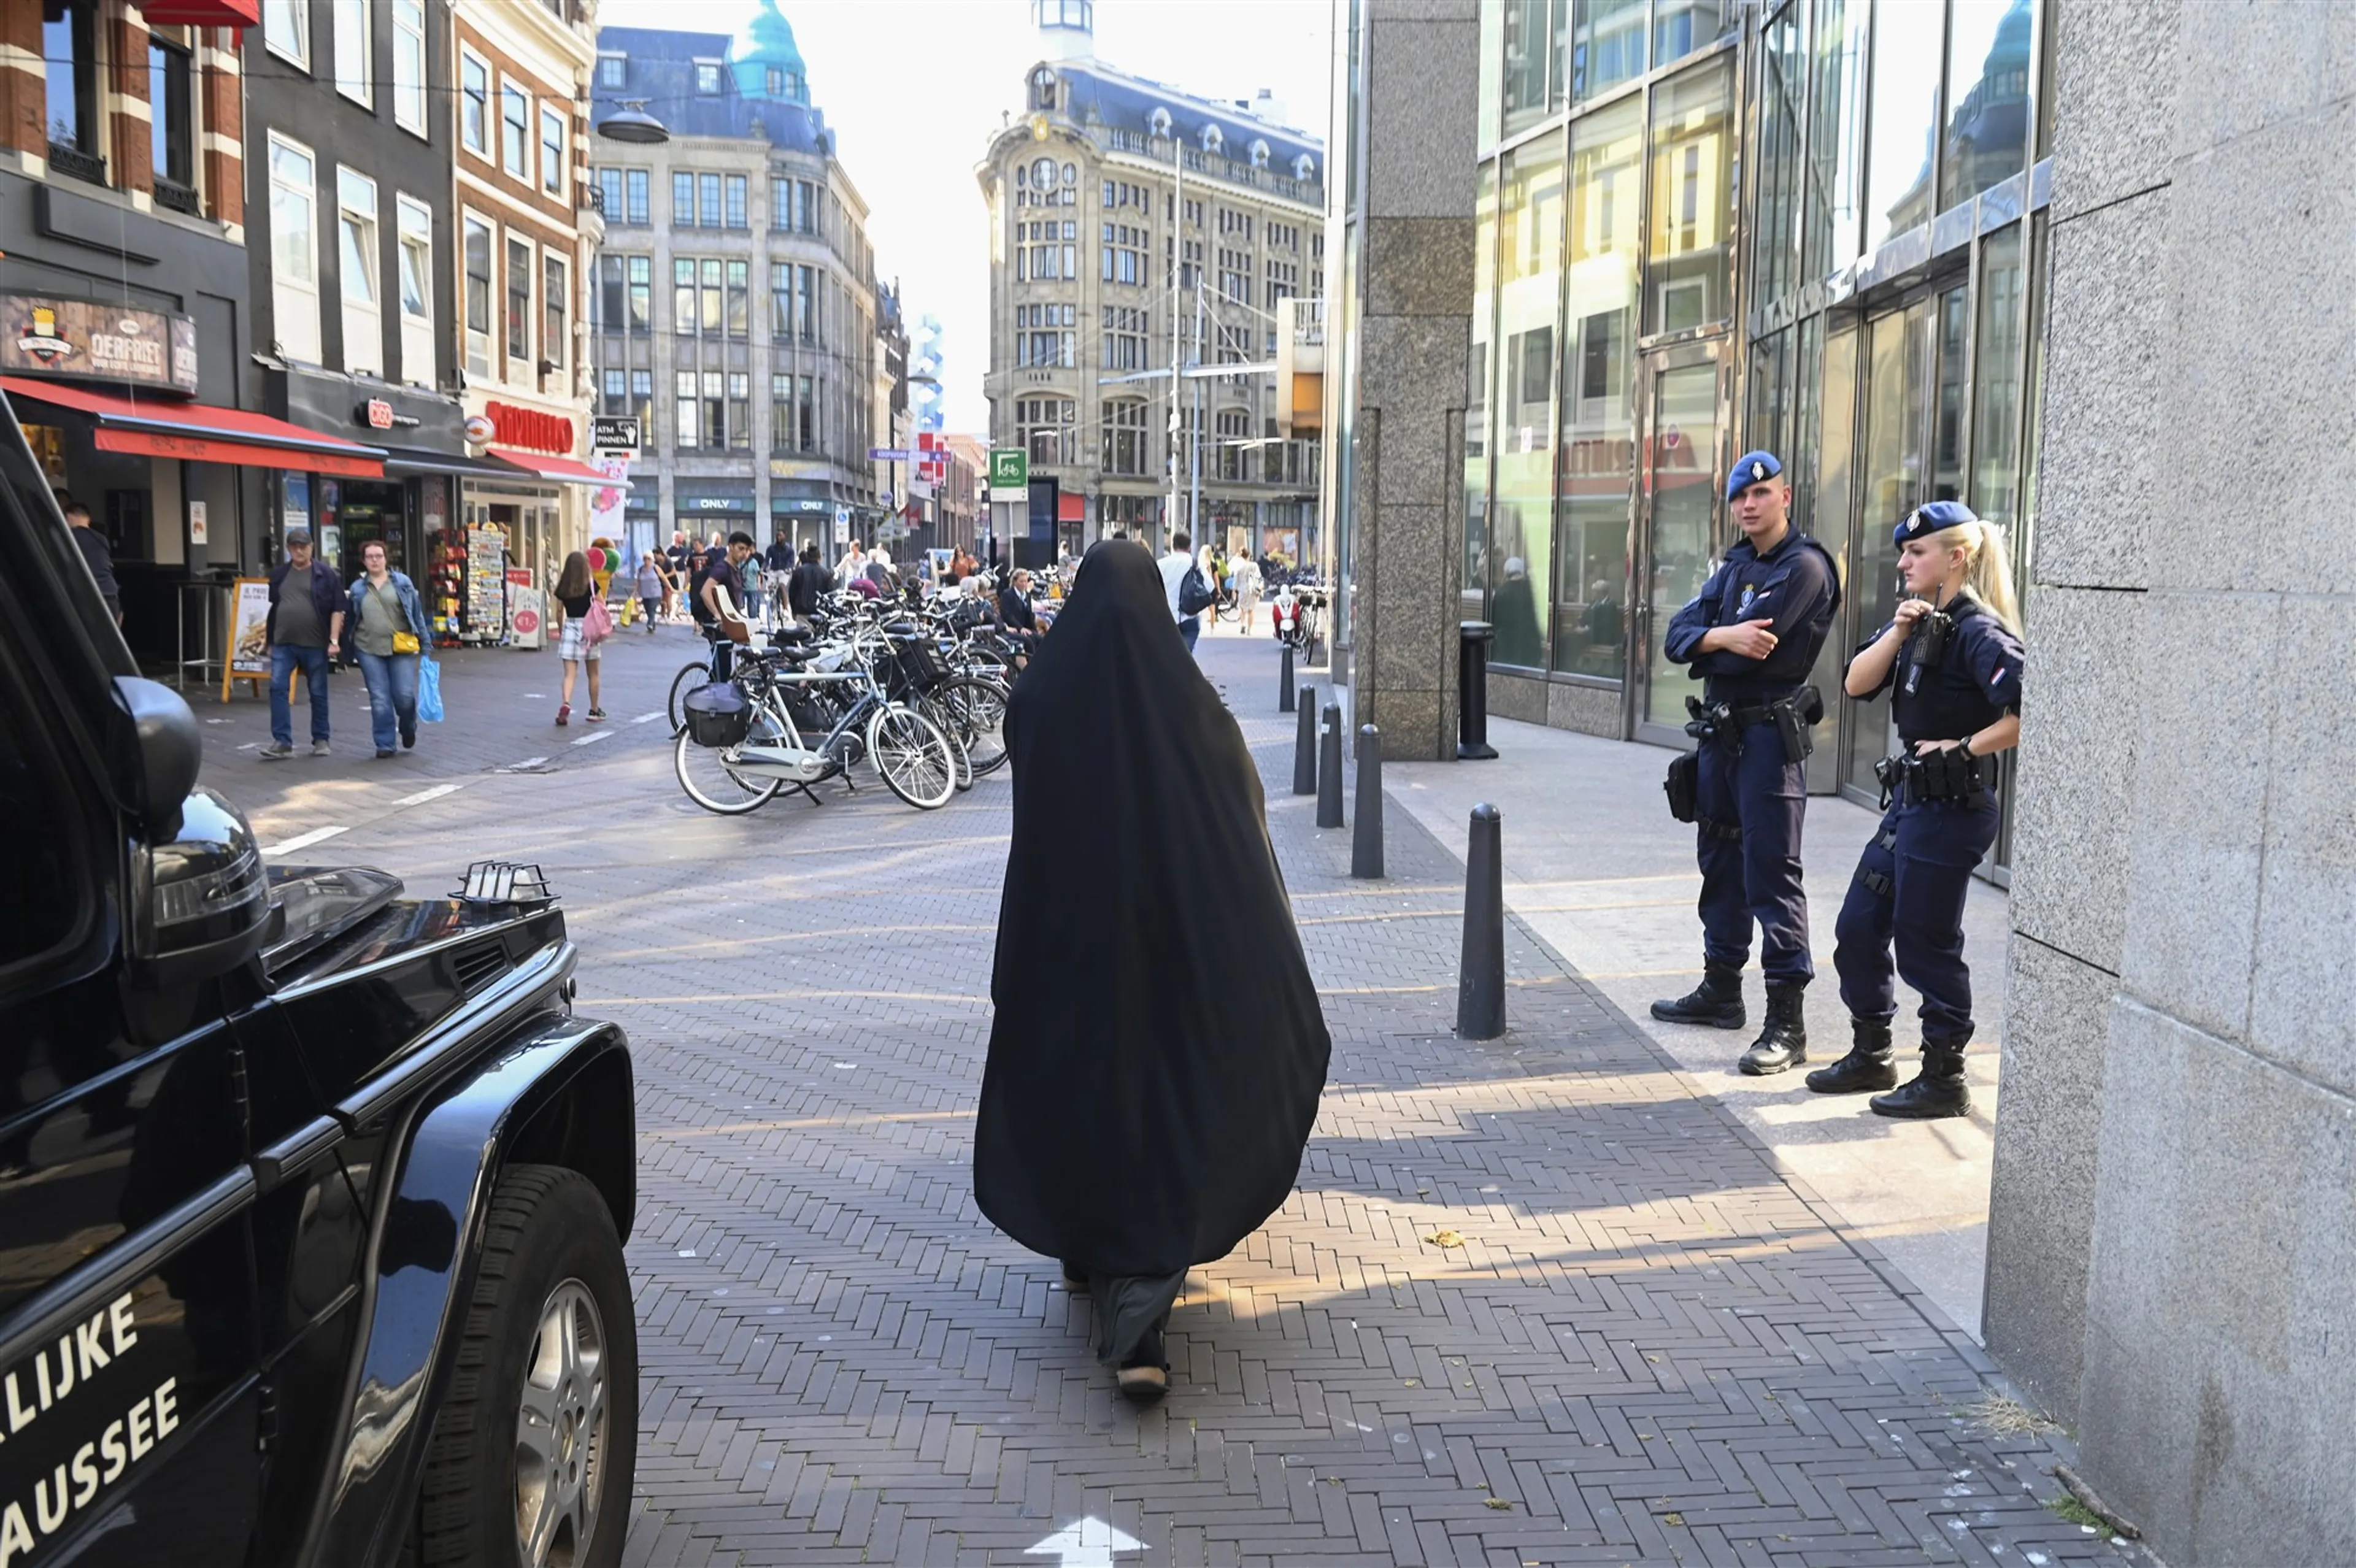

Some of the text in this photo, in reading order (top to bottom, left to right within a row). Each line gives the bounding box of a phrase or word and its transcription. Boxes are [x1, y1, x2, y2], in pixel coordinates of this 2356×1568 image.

[597, 425, 615, 434] ATM
[597, 435, 627, 444] PINNEN
[700, 498, 730, 509] ONLY
[801, 501, 823, 511] ONLY
[0, 1292, 138, 1444] LIJKE
